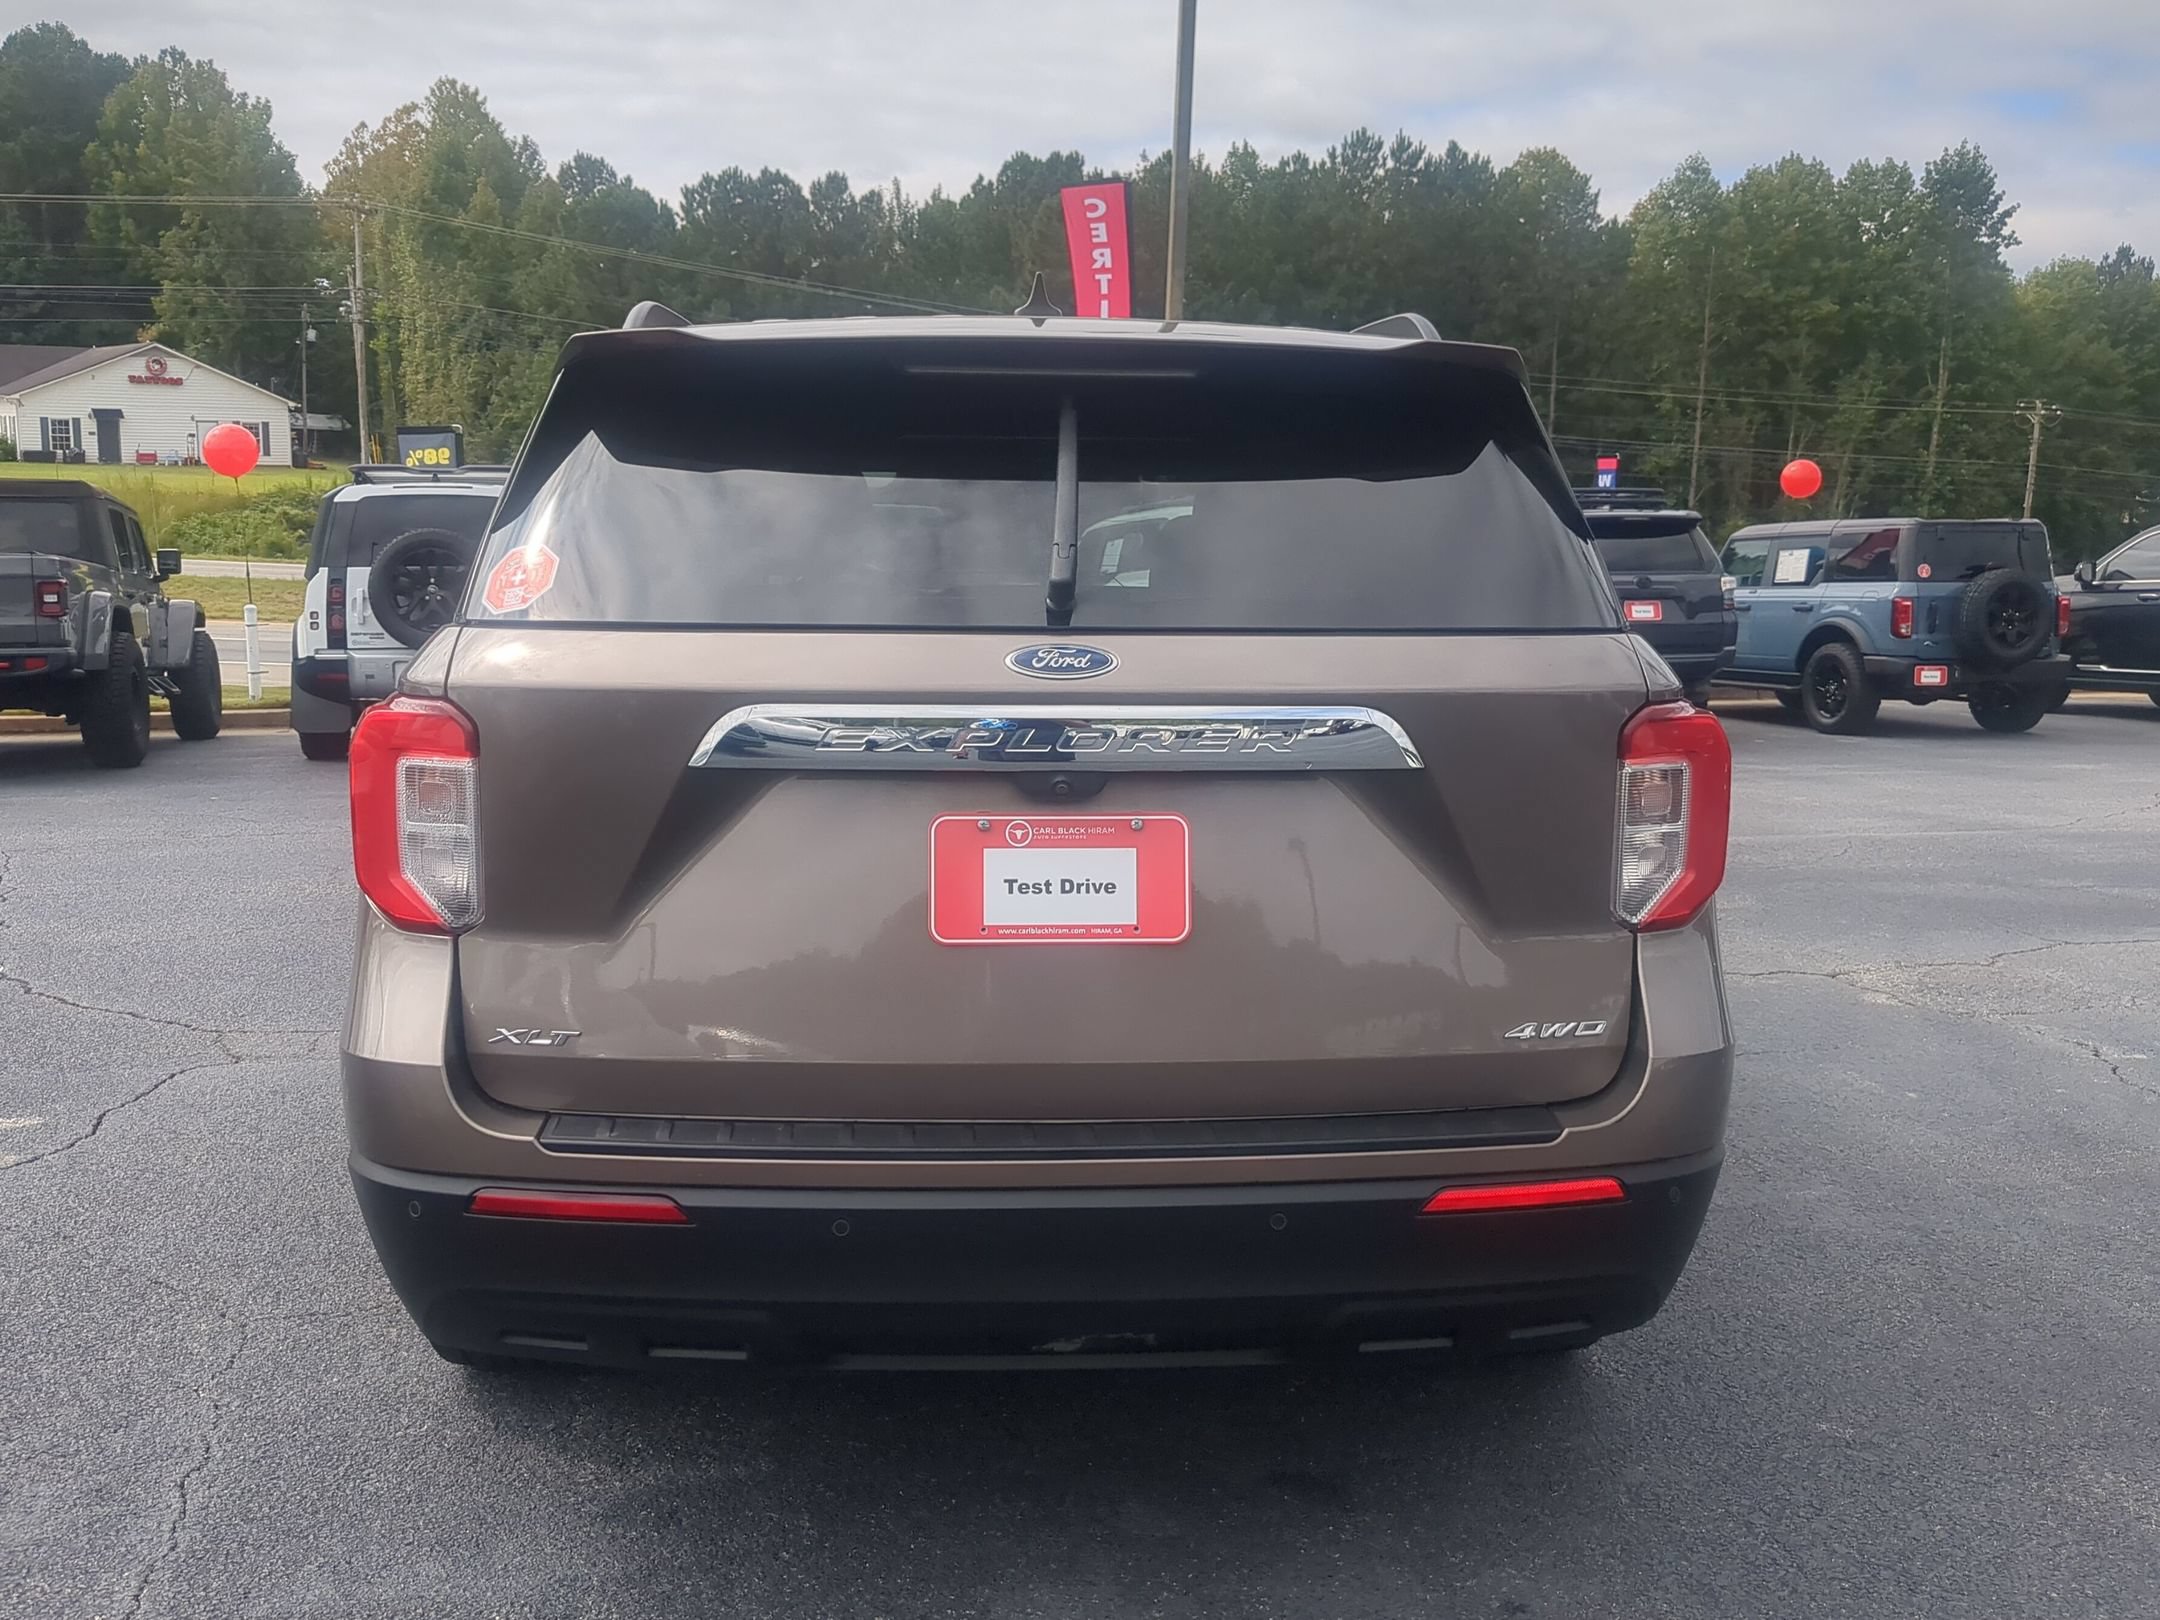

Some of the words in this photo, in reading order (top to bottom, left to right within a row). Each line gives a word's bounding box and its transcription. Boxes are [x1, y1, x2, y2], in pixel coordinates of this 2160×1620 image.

[1031, 648, 1091, 668] Ford
[815, 726, 1299, 753] EXPLORER
[1003, 879, 1052, 894] Test
[1060, 878, 1117, 894] Drive
[488, 1028, 582, 1046] XLT
[1504, 1020, 1607, 1039] 4WD
